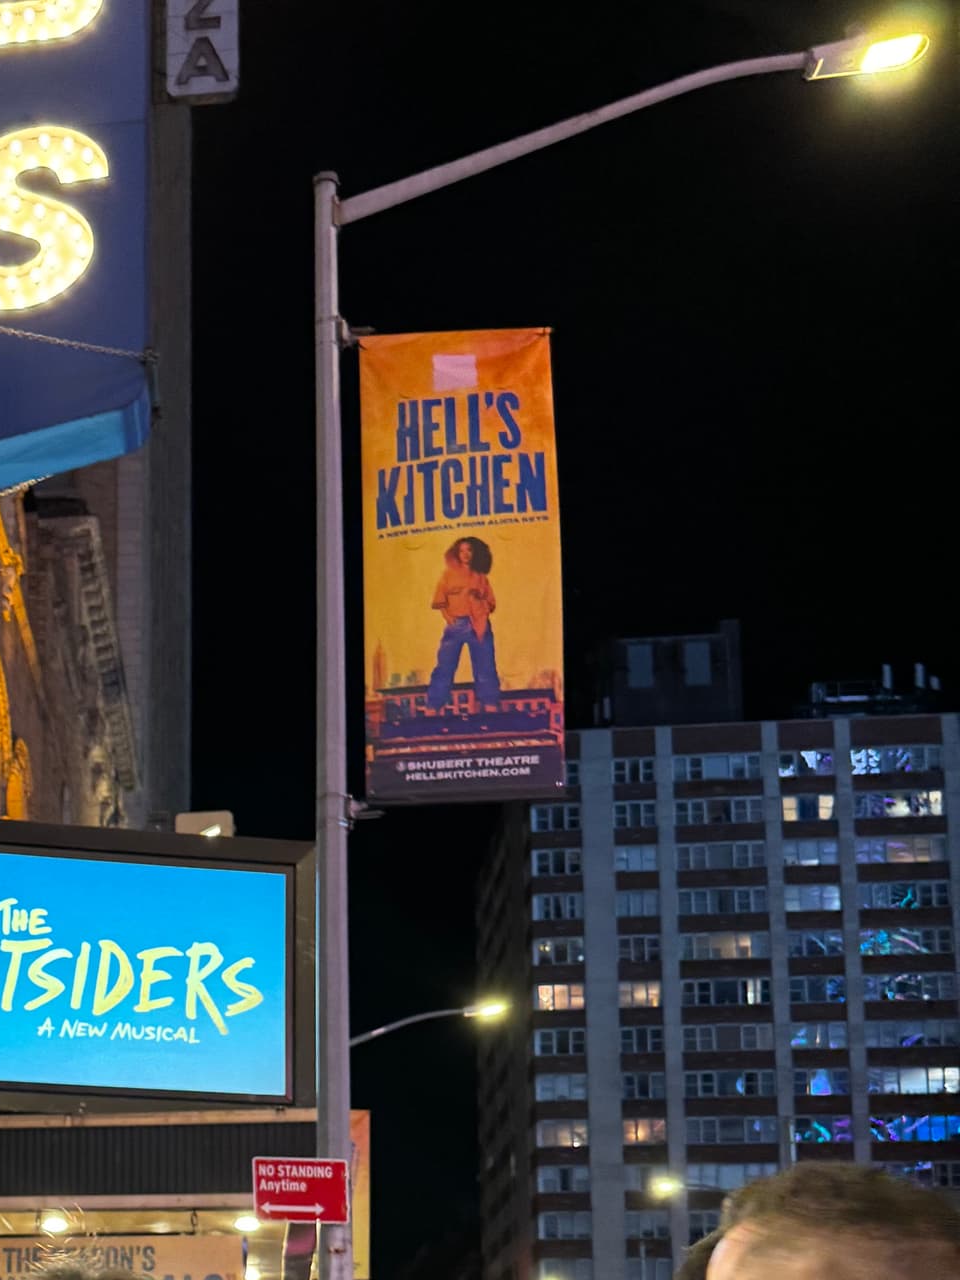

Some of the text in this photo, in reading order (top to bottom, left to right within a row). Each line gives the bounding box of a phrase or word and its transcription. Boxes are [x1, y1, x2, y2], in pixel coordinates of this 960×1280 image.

[396, 392, 521, 462] HELL'S
[376, 452, 547, 530] KITCHEN
[407, 755, 540, 771] SHUBERT THEATRE
[405, 767, 531, 782] HELLSKITCHEN.COM
[37, 1017, 200, 1044] A NEW MUSICAL
[258, 1164, 333, 1178] NO STANDING
[259, 1179, 308, 1195] Anytime
